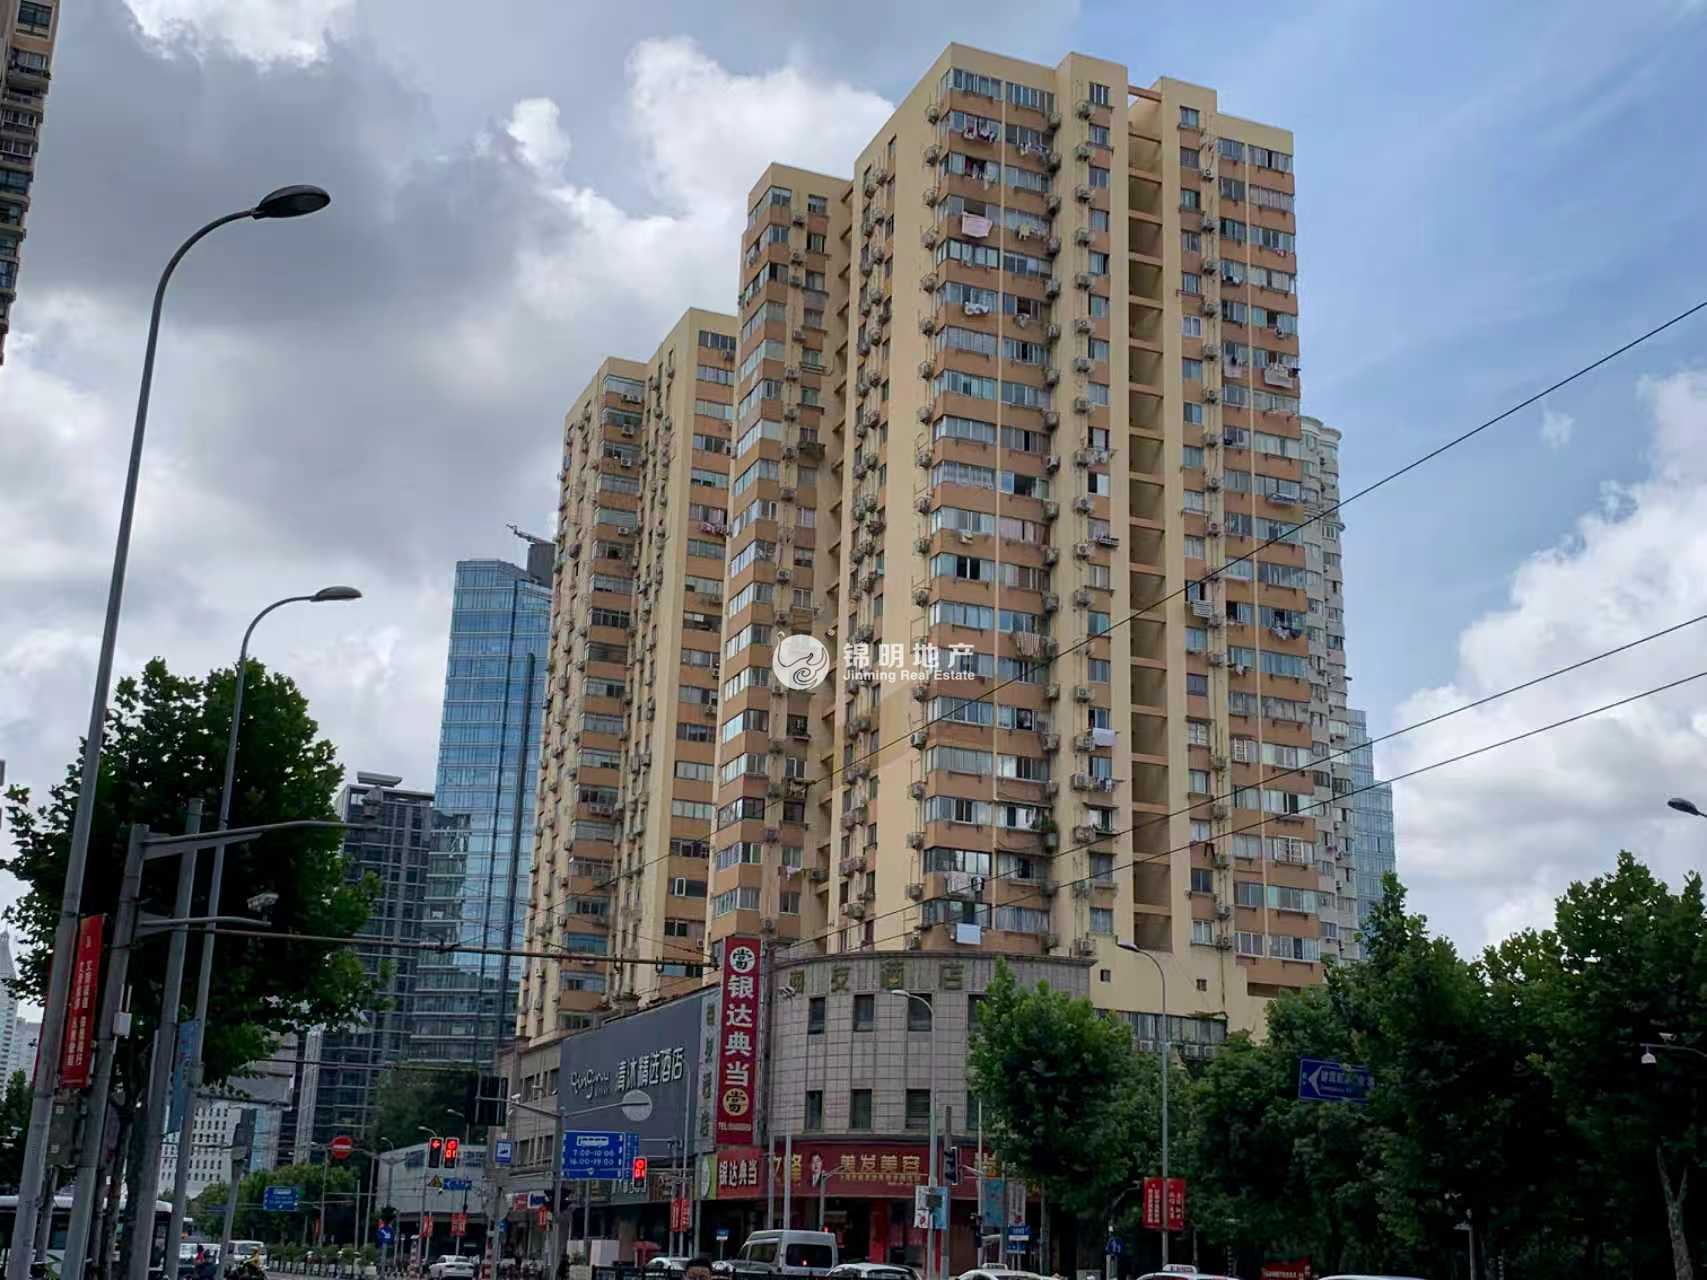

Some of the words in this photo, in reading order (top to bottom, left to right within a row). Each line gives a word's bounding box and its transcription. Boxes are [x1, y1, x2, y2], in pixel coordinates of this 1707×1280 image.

[725, 975, 754, 1087] 银达典当
[719, 1159, 758, 1187] 银达典当
